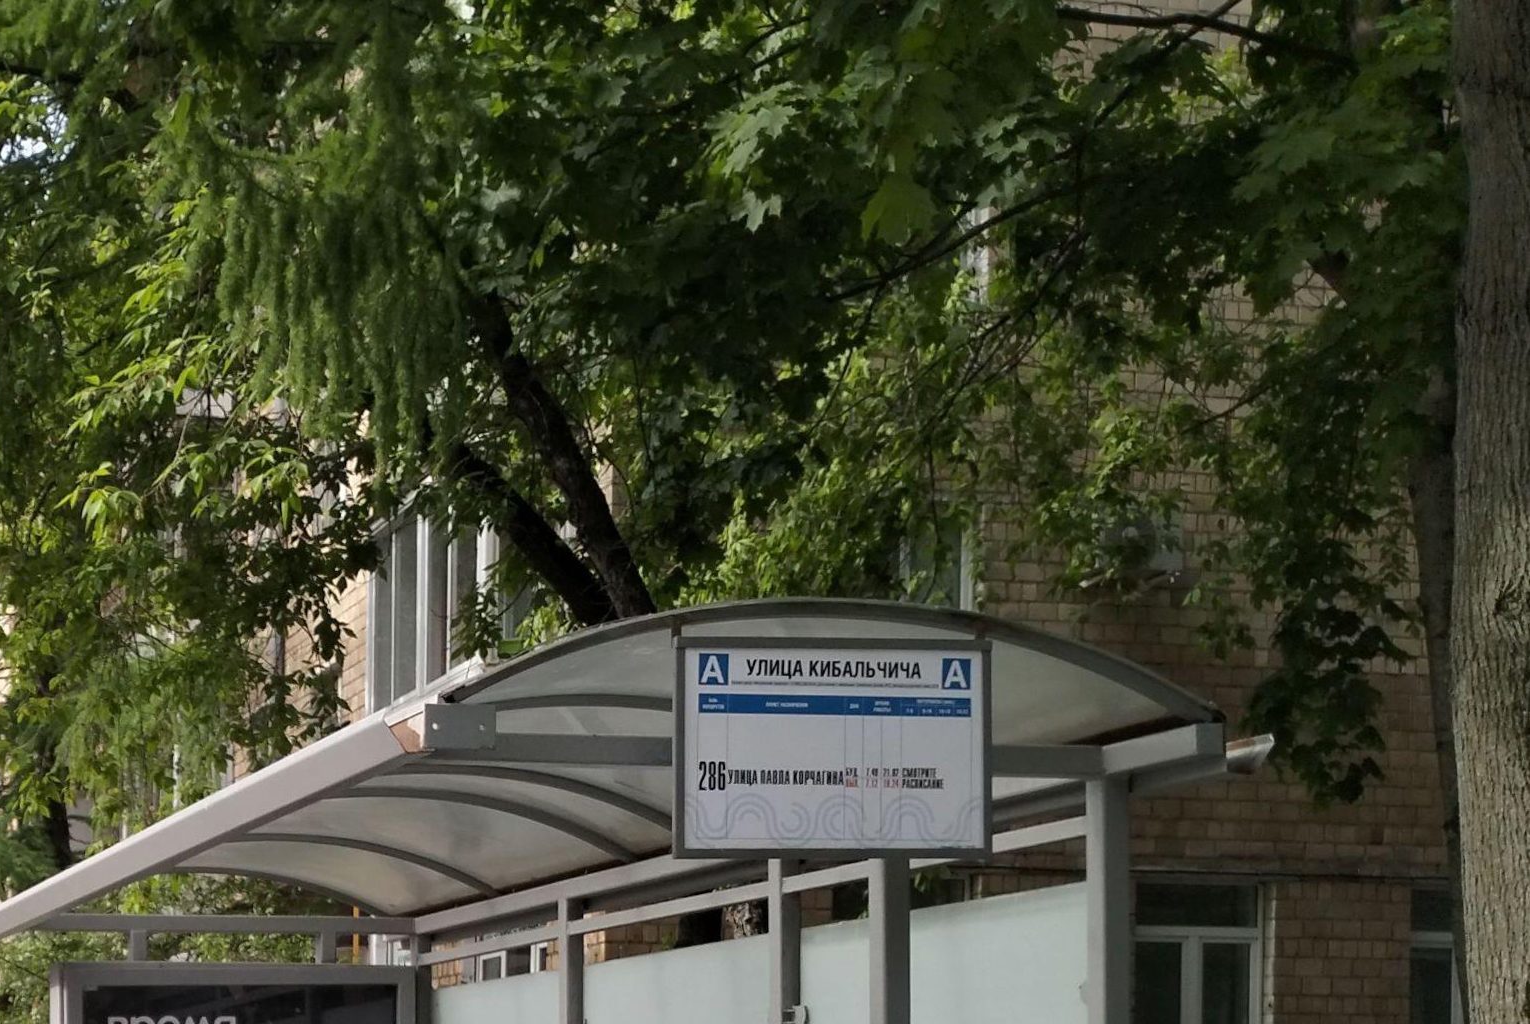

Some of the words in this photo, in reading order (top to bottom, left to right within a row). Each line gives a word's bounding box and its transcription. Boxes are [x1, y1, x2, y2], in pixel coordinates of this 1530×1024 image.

[746, 658, 803, 679] УЛИЦА
[809, 660, 922, 679] КИБАЛЬЧИЧА
[699, 761, 726, 791] 286
[728, 769, 758, 786] УЛИЦА
[760, 769, 790, 786] ПАВЛА
[793, 770, 844, 786] КОРЧАГИНА
